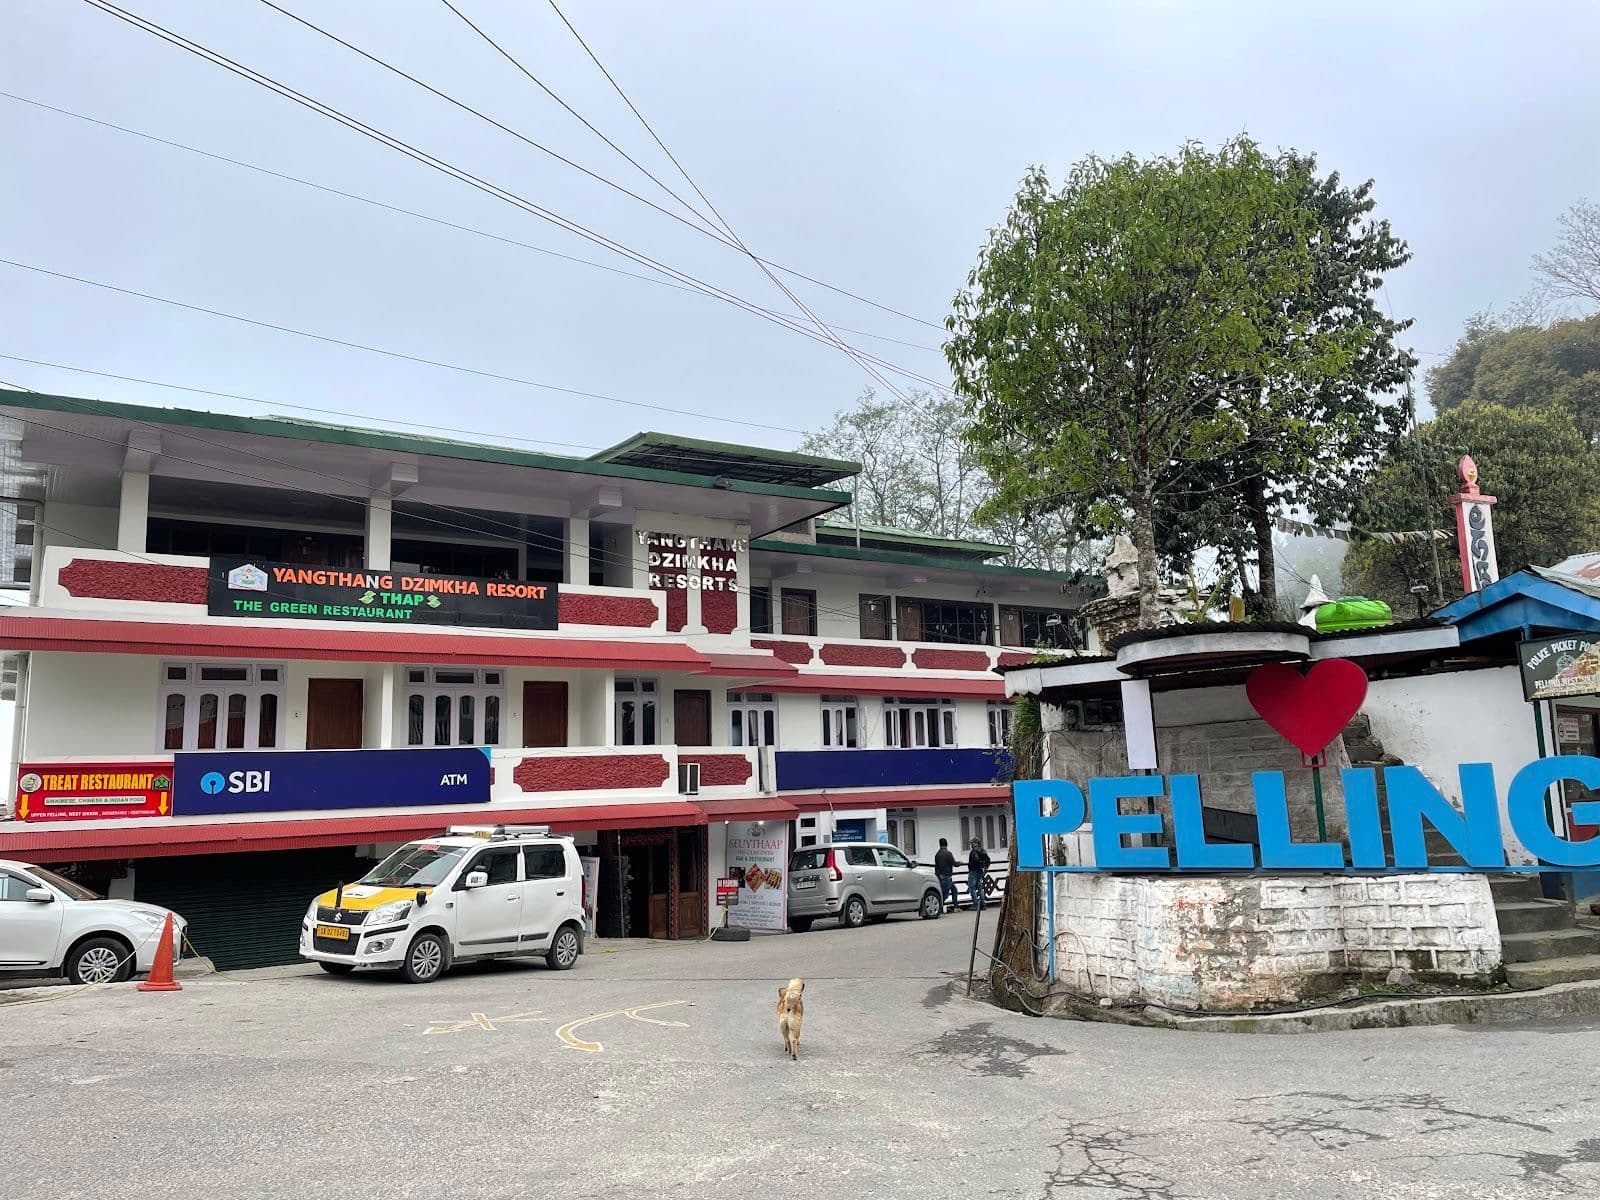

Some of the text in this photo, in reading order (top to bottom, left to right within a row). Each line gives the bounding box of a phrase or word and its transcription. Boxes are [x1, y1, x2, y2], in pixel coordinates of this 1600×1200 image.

[648, 551, 738, 572] DZIMKHA
[272, 567, 547, 600] YANGTHANG DZIMKHA RESORT
[648, 572, 738, 592] RESORTS
[380, 591, 424, 606] THAP
[233, 599, 412, 620] THE GREEN RESTAURANT
[1526, 646, 1552, 670] POLICE
[1550, 639, 1578, 654] PICKET
[1121, 680, 1157, 770] I
[42, 773, 154, 791] TREAT RESTAURANT
[228, 770, 271, 793] SBI
[440, 773, 468, 786] ATM
[1013, 756, 1600, 870] PELLING
